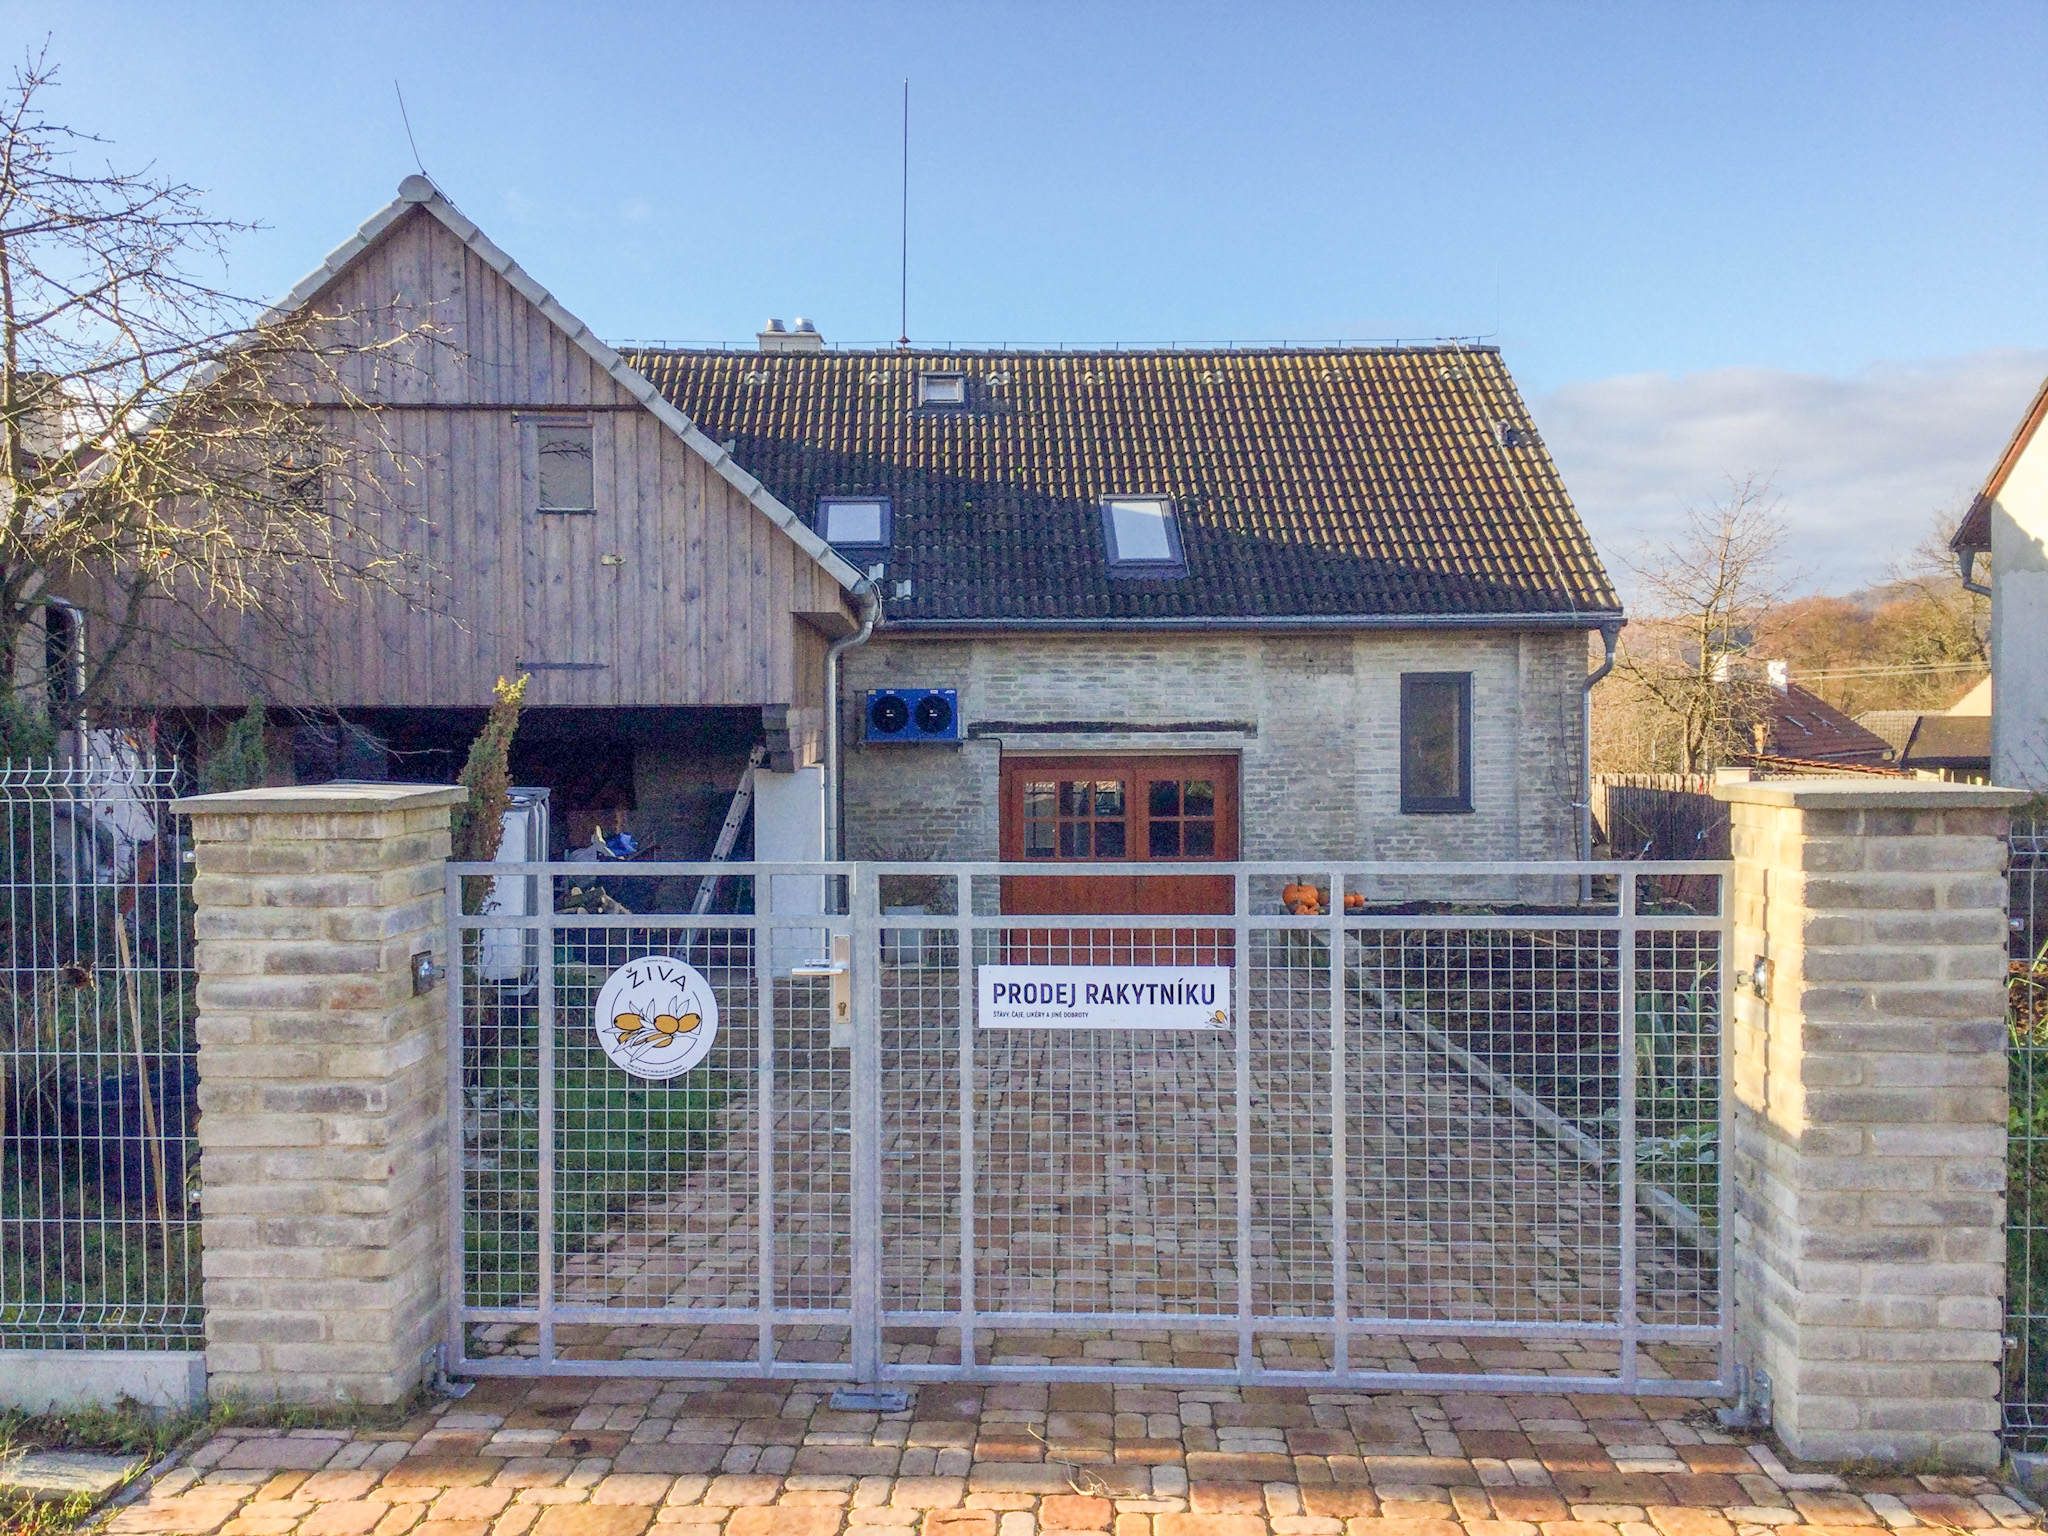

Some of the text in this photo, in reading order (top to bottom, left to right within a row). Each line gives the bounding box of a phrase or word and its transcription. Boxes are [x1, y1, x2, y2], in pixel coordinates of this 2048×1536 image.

[626, 965, 686, 992] ŽIVA
[993, 978, 1215, 1008] PRODEJ RAKYTNÍKU
[1026, 1010, 1045, 1018] LIKÉRY
